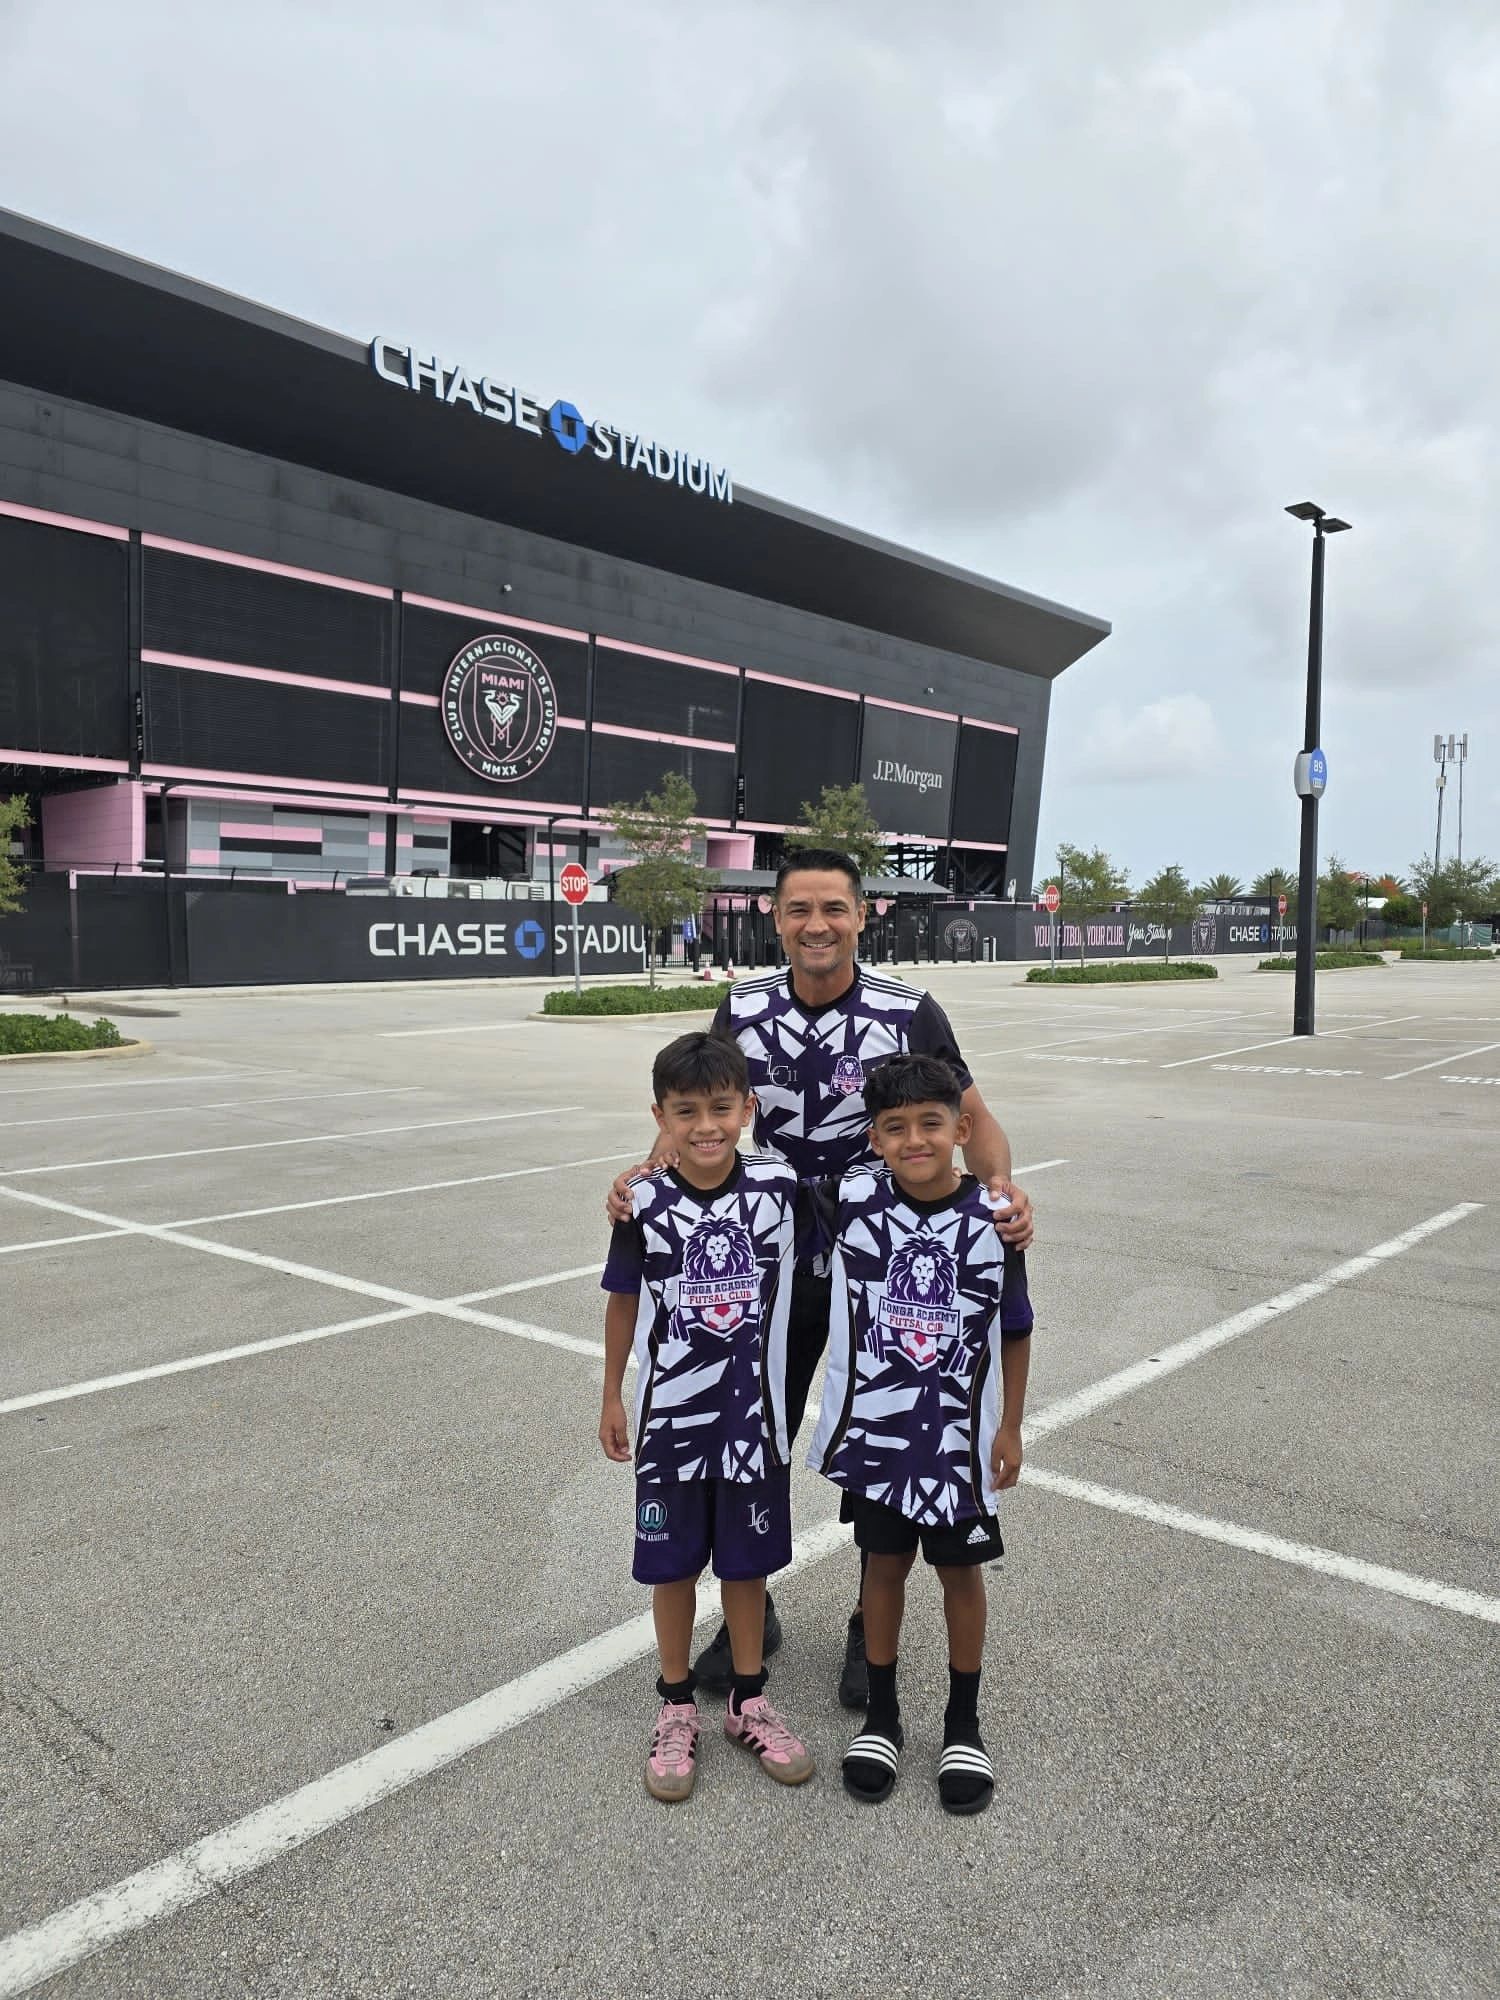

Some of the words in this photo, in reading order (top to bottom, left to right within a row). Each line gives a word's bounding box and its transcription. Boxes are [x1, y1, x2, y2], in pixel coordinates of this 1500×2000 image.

[370, 336, 544, 438] CHASE
[592, 419, 733, 504] STADIUM
[449, 641, 539, 693] INTERNACIONAL
[481, 672, 525, 691] MIAMI
[538, 675, 551, 695] DE
[447, 701, 464, 741] CLUB
[482, 760, 518, 776] MMXX
[562, 876, 588, 892] STOP
[368, 923, 507, 956] CHASE
[1086, 924, 1106, 946] YOUR
[1229, 926, 1260, 942] CHASE
[689, 1294, 726, 1305] FUTSAL
[728, 1290, 752, 1300] CLUB
[889, 1314, 925, 1331] FUTSAL
[916, 1308, 957, 1324] ACAEMY
